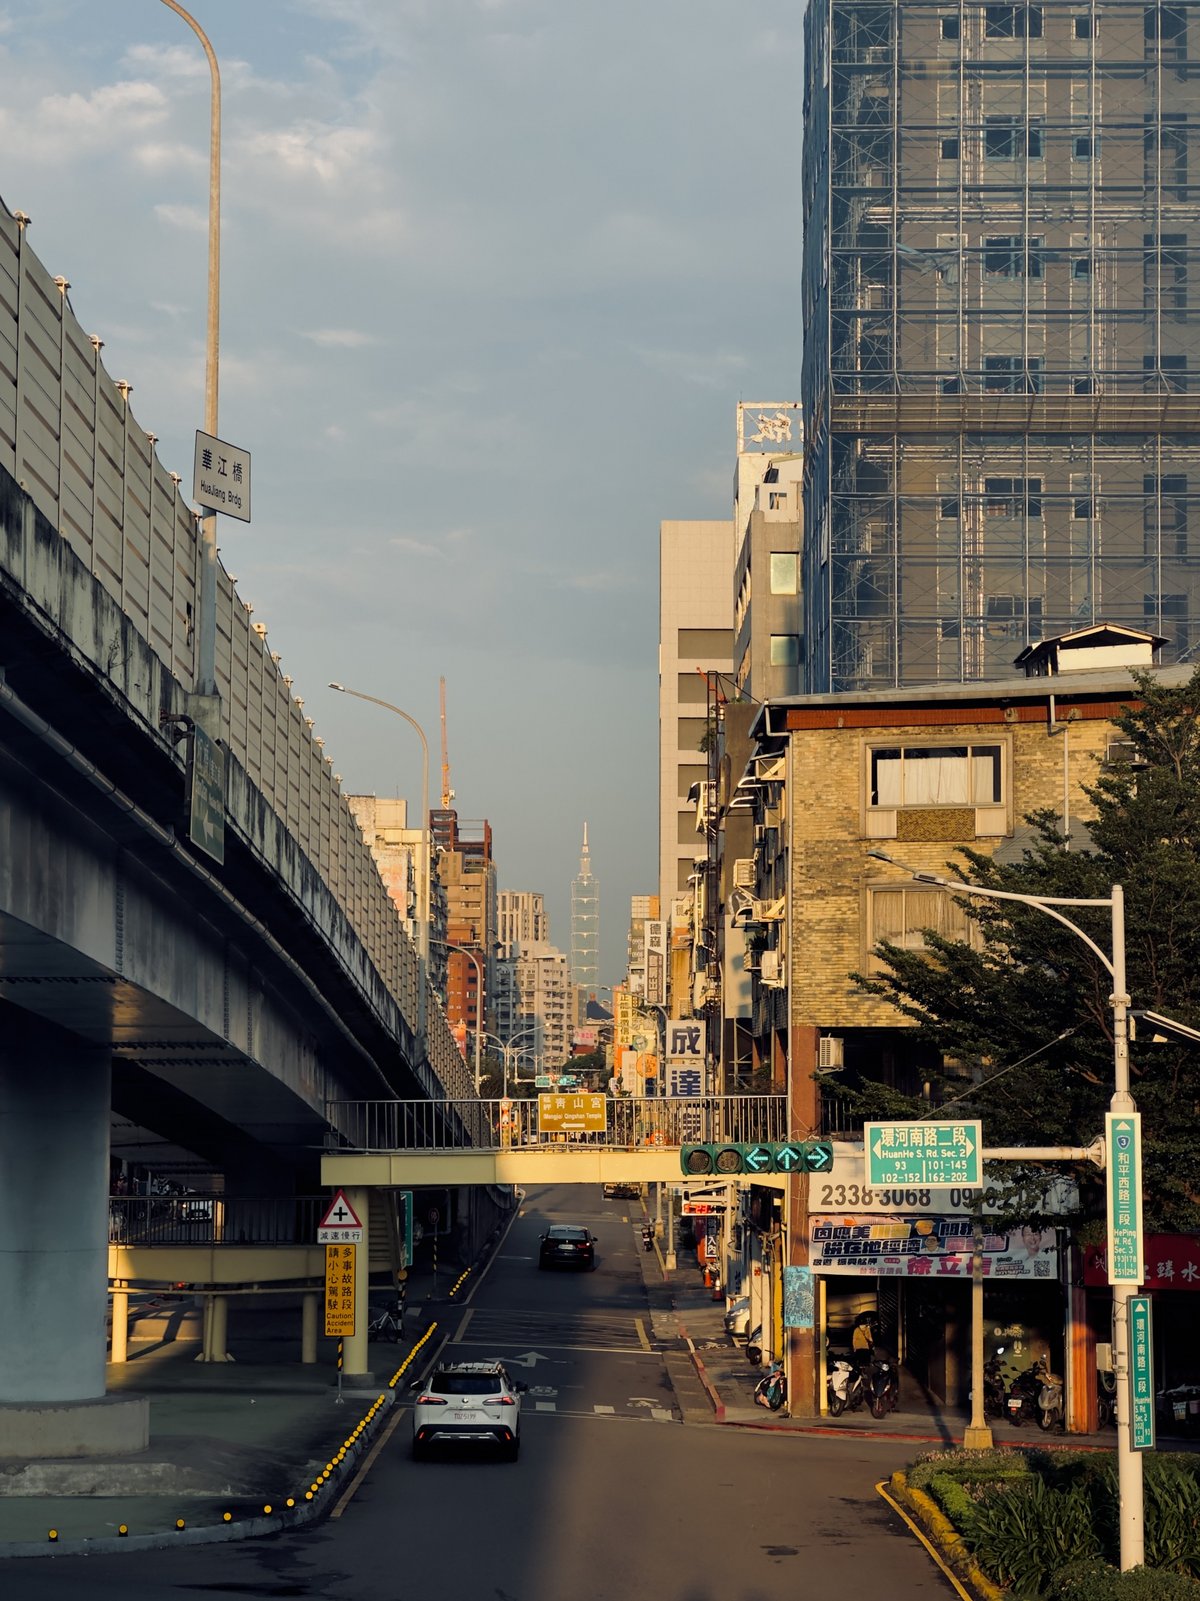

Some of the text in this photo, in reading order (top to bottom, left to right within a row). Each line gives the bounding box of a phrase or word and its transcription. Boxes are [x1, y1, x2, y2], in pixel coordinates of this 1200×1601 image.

[202, 449, 243, 484] 華江橋
[881, 1127, 966, 1147] 環河南路二段
[1121, 1138, 1126, 1146] 3
[916, 1150, 924, 1158] S.
[926, 1150, 939, 1158] Rd.
[941, 1150, 957, 1158] Sec.
[960, 1149, 965, 1157] 2
[895, 1160, 967, 1170] 93 101-145
[882, 1173, 967, 1182] 102-152 162-202
[820, 1185, 931, 1206] 2338-3068
[1118, 1153, 1130, 1225] 和平西路三段
[320, 1231, 360, 1240] 減速慢行
[1114, 1229, 1136, 1238] HePing
[327, 1248, 339, 1310] 請小心駕駛
[341, 1248, 352, 1310] 多事故路段
[1136, 1319, 1146, 1393] 環河南路二段
